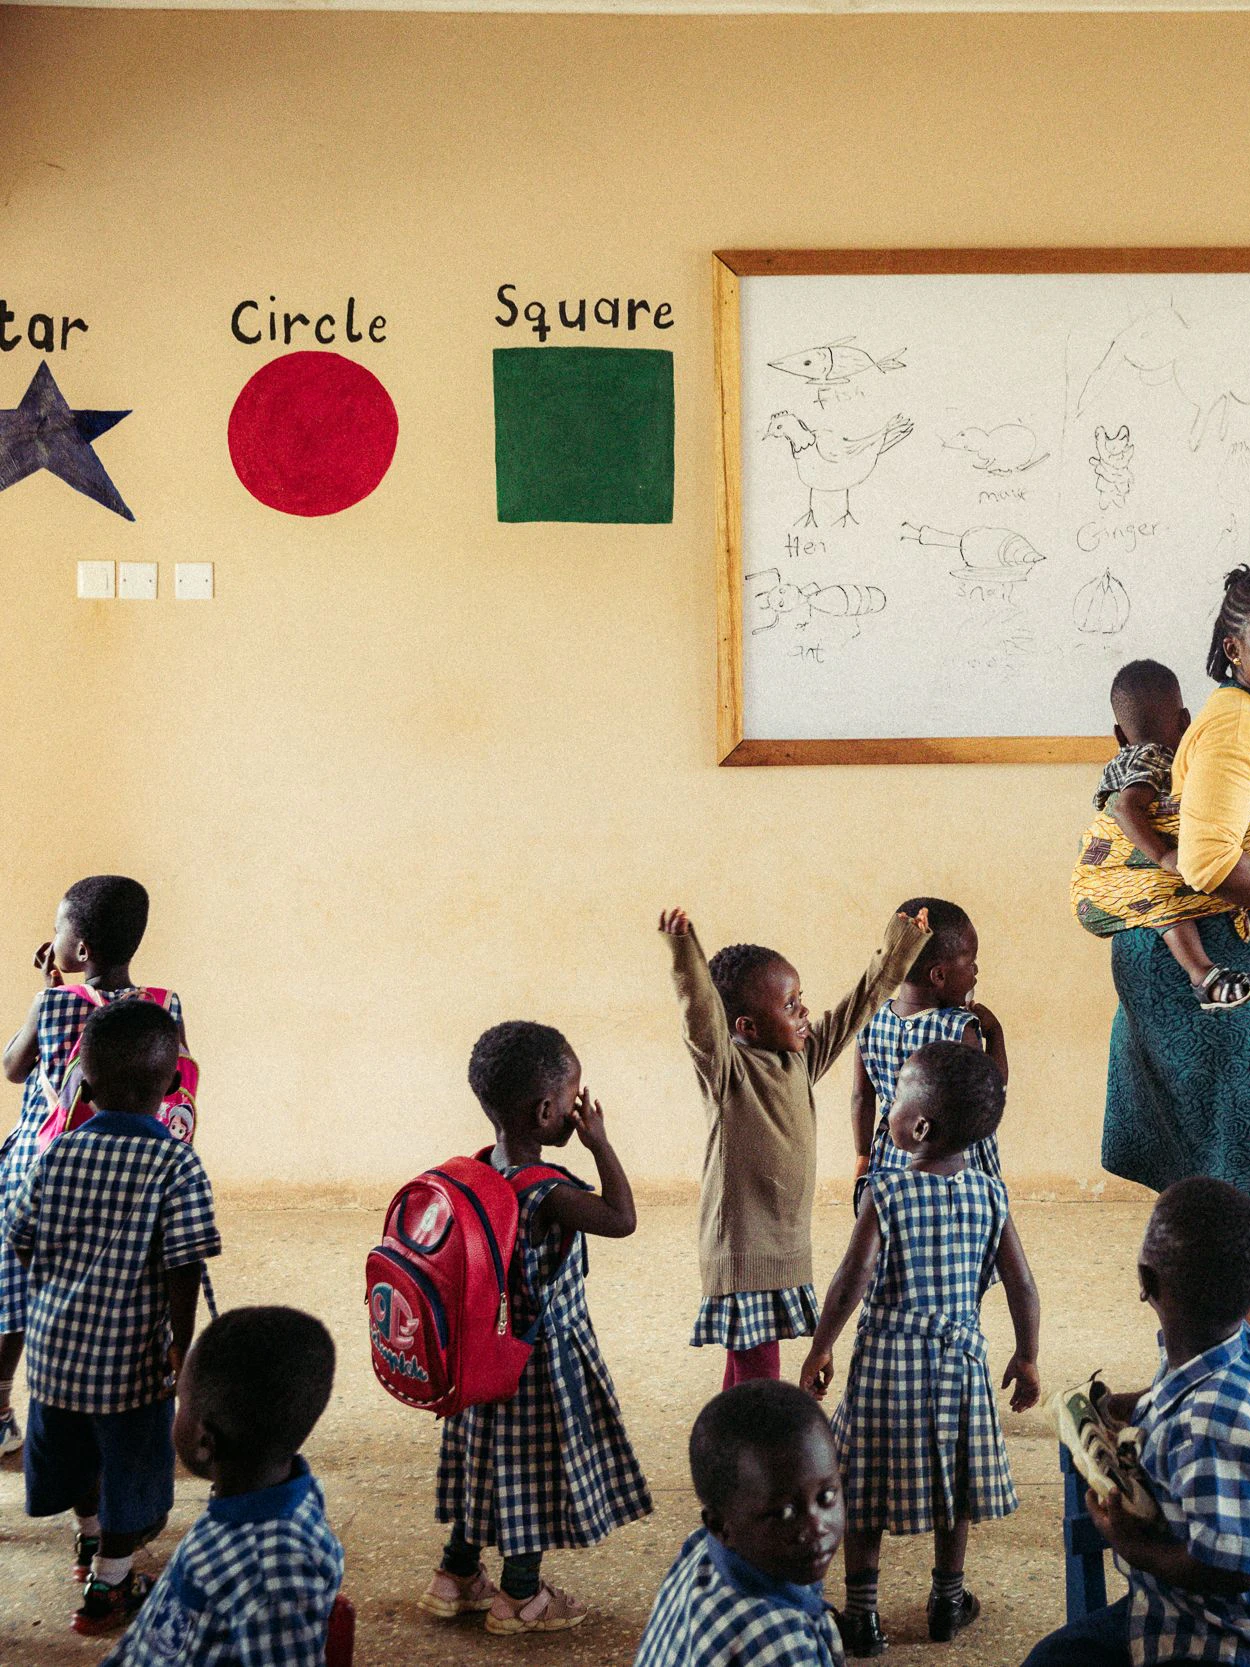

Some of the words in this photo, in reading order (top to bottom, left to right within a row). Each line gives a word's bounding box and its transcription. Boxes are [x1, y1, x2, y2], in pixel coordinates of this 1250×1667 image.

[231, 296, 388, 345] Circle
[494, 282, 675, 343] Square
[785, 532, 826, 558] Hen
[1075, 520, 1161, 553] Ginger
